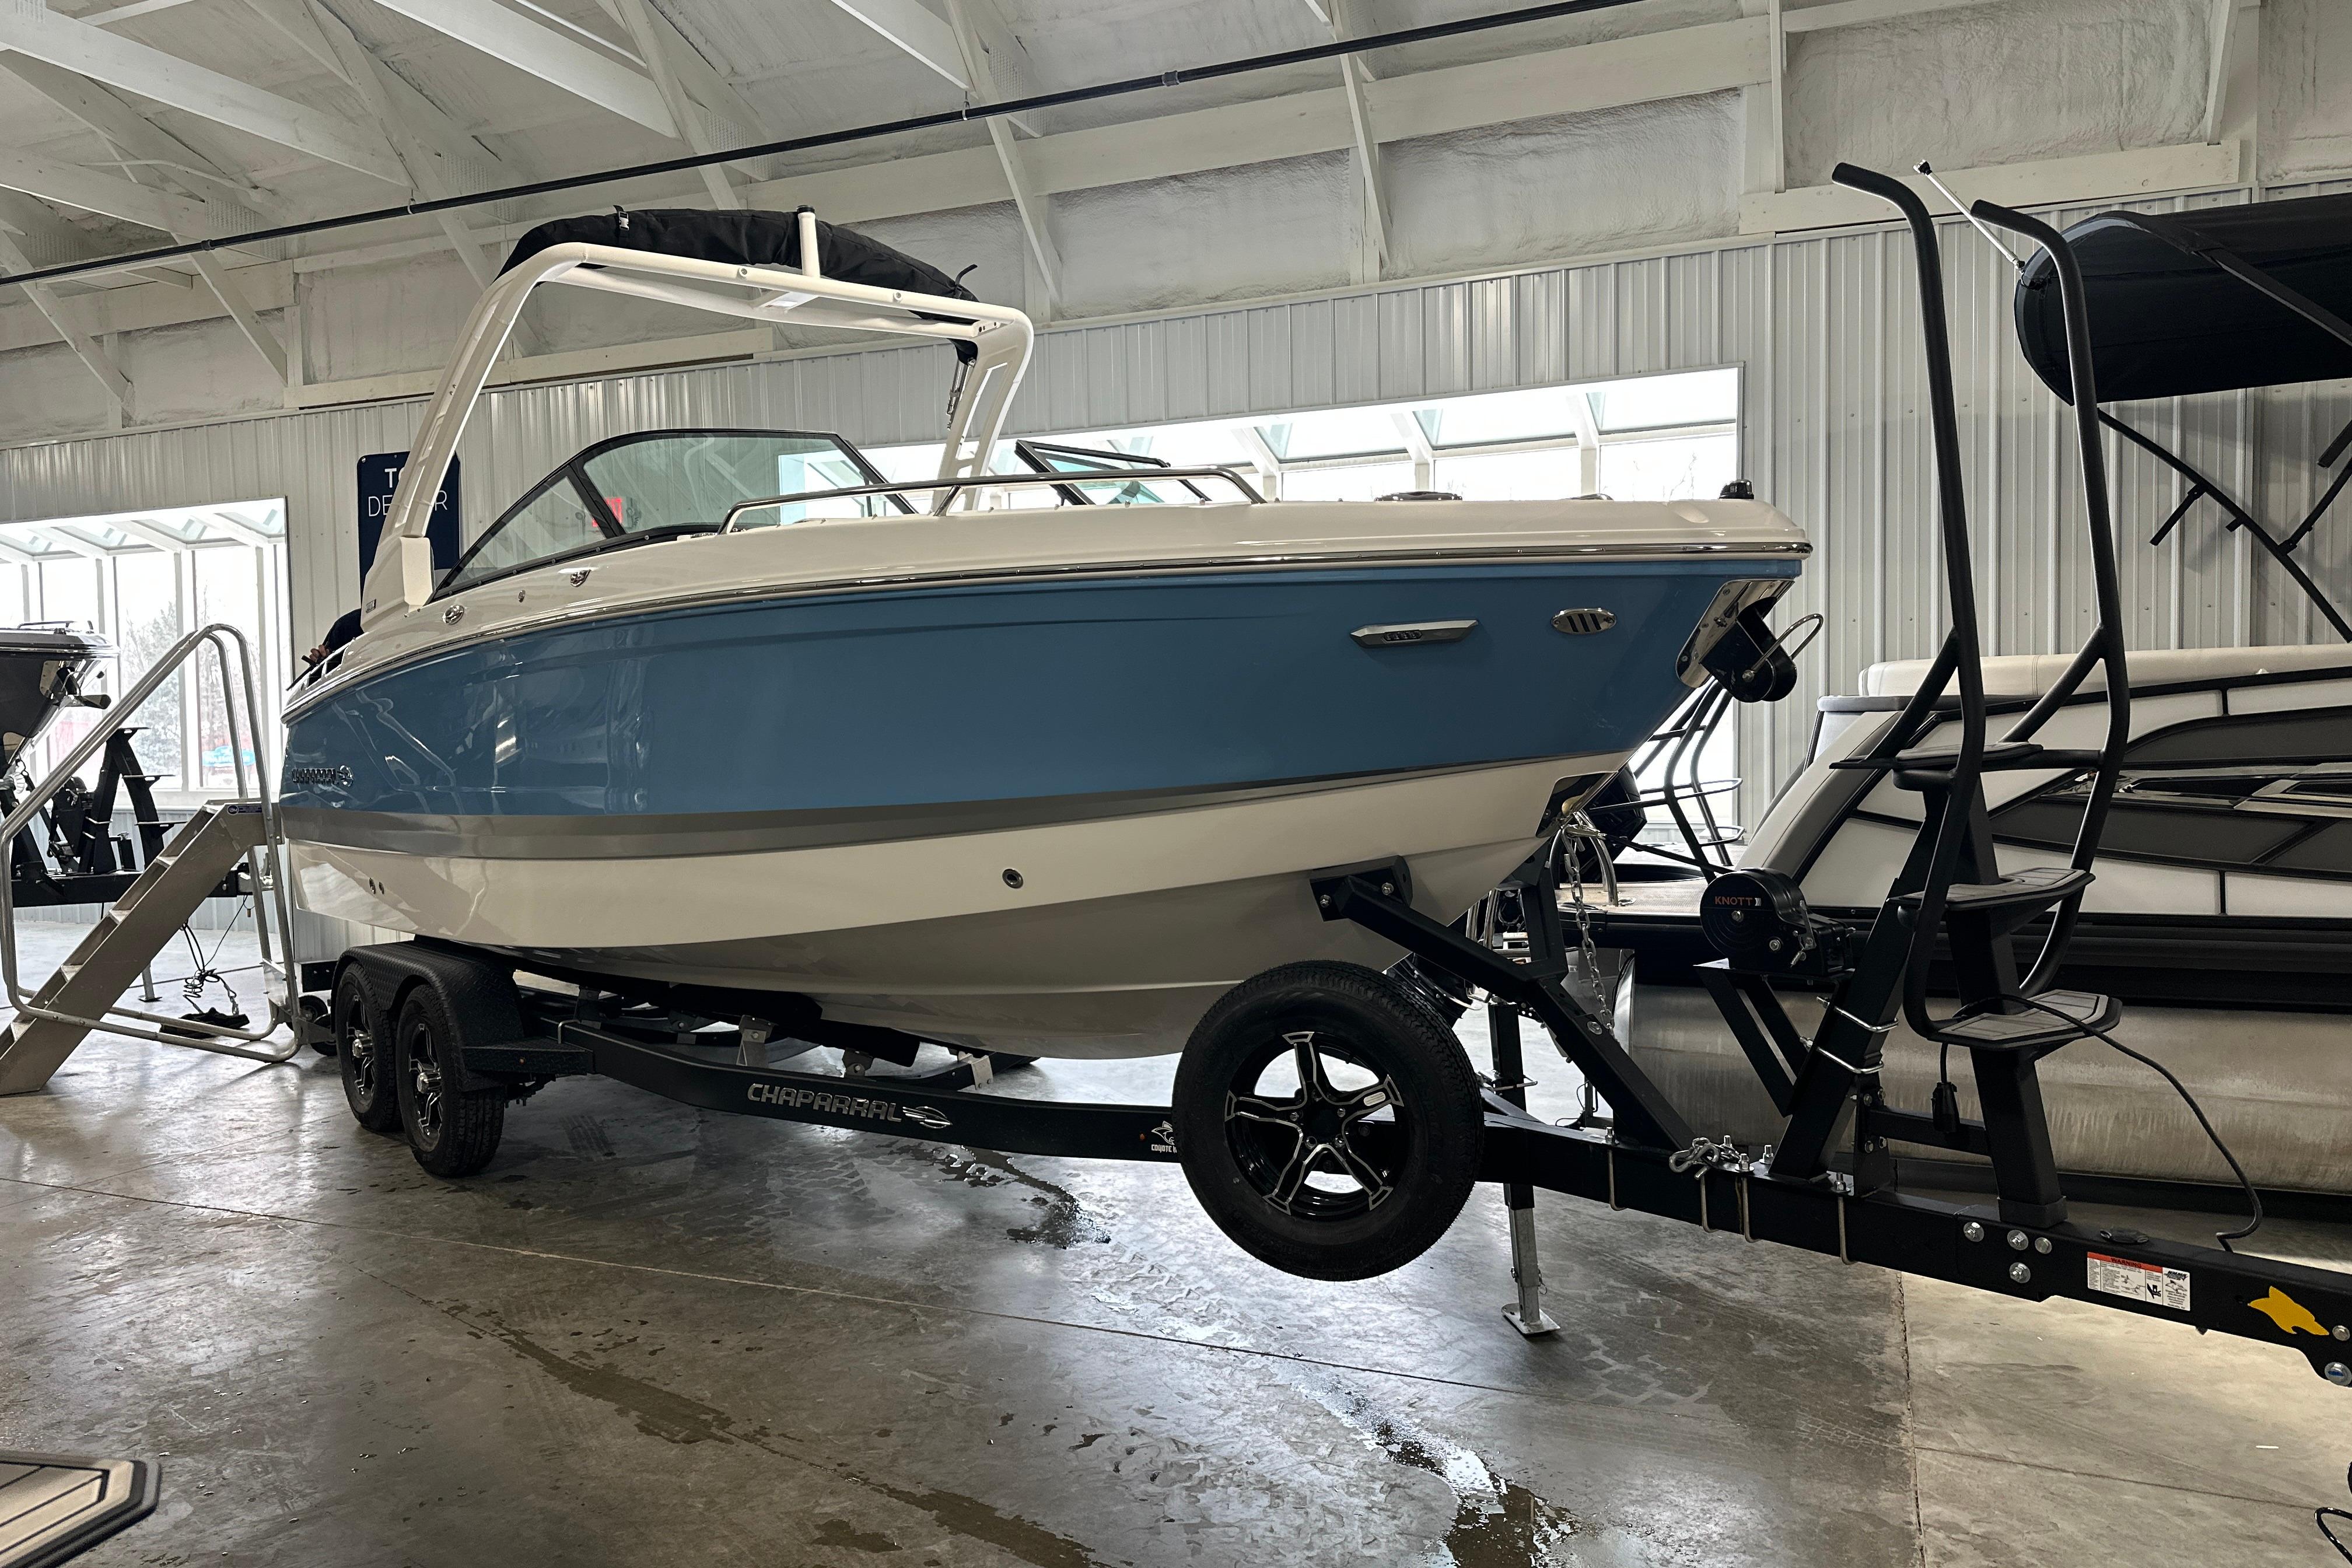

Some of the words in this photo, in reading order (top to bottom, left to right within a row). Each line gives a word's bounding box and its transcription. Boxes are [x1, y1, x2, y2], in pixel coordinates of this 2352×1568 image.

[1715, 896, 1753, 906] KNOTT
[747, 1083, 901, 1122] CHAPARRAL
[2110, 1257, 2142, 1269] WARNING
